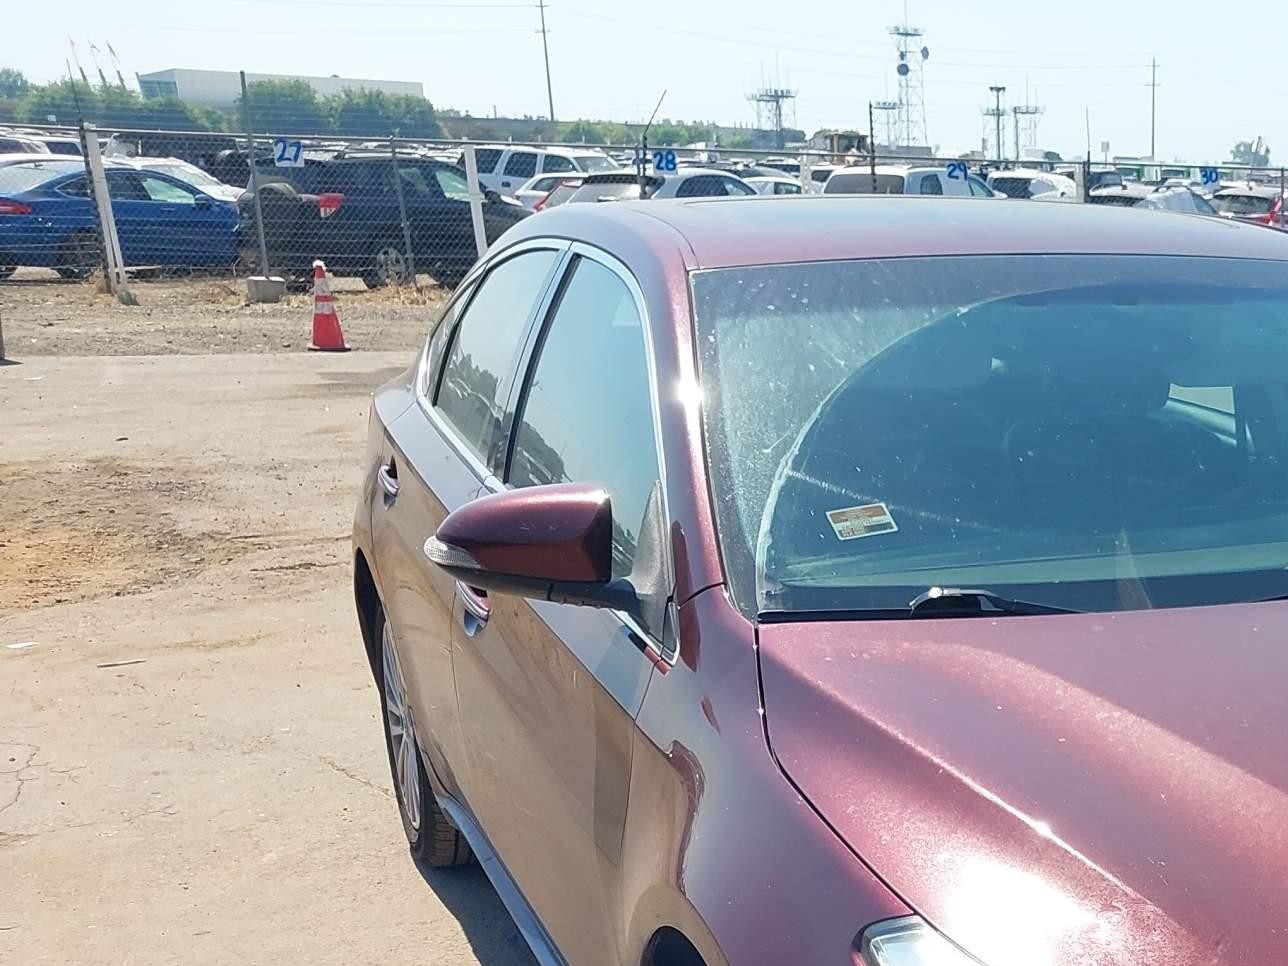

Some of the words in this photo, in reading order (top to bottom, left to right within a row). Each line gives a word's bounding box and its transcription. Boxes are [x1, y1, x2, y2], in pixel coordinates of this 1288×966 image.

[274, 139, 302, 164] 27
[653, 150, 677, 172] 28
[947, 162, 968, 181] 29
[1200, 168, 1218, 184] 30
